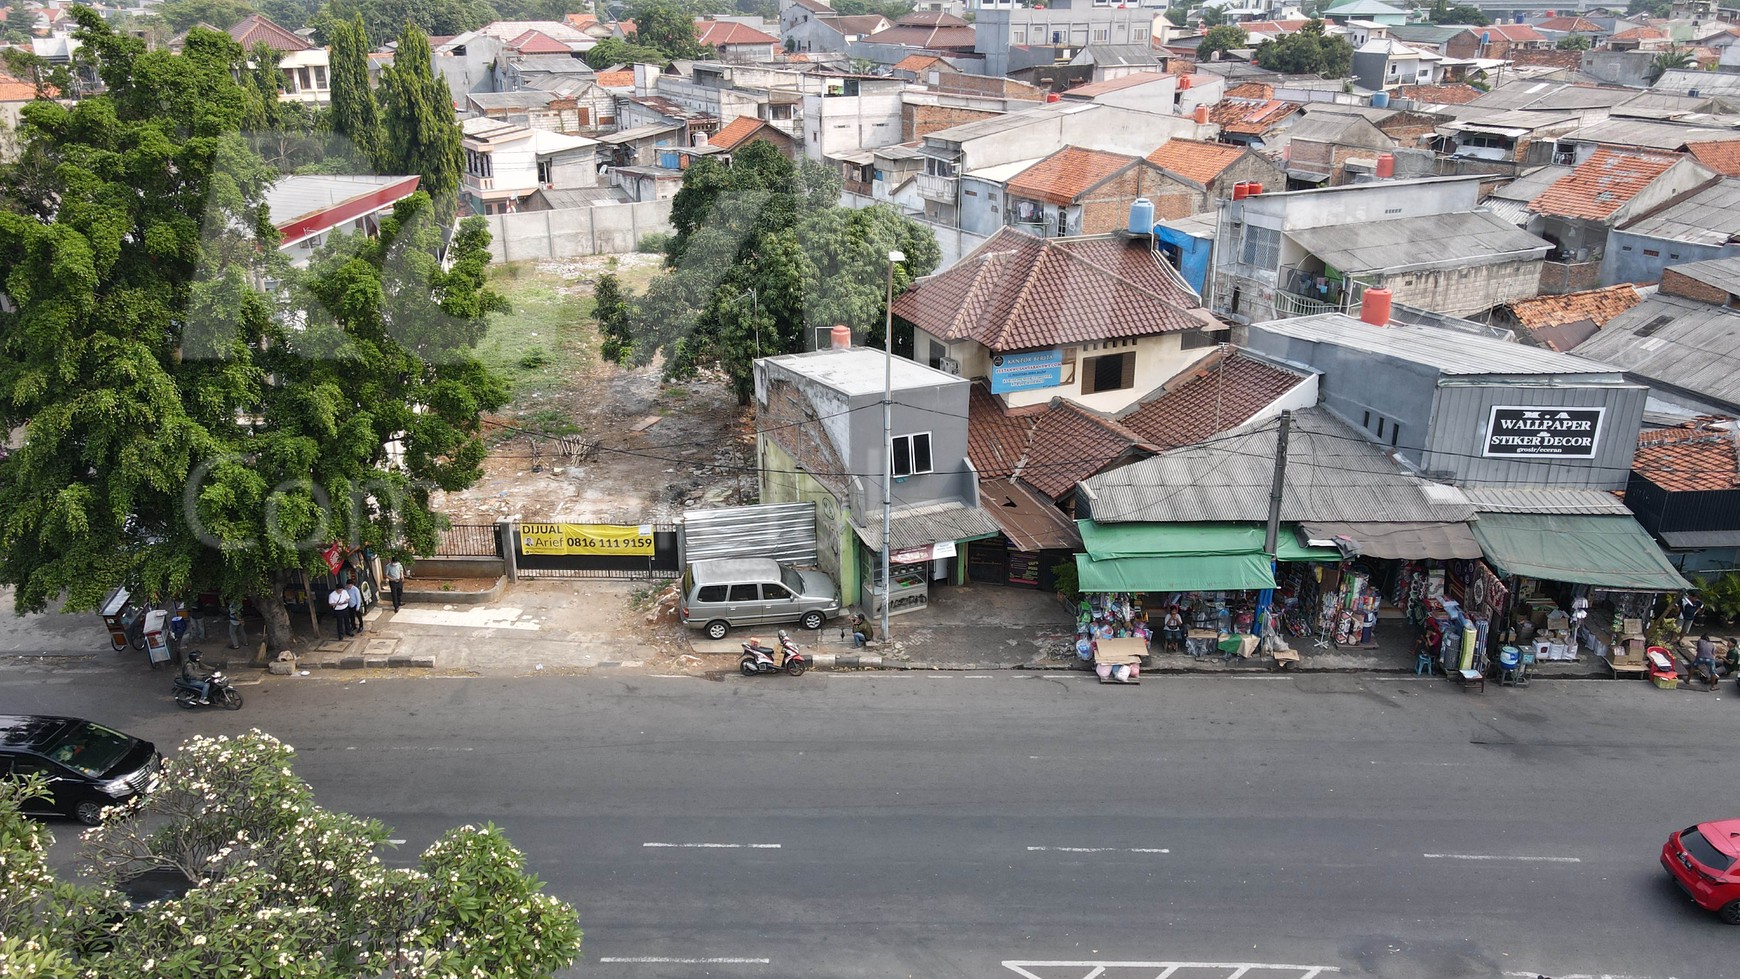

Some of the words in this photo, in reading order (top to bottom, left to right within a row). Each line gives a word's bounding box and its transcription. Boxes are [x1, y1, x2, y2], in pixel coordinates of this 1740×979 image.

[1500, 419, 1592, 431] WALLPAPER
[1491, 435, 1542, 446] STIKER
[1543, 436, 1592, 447] DECOR
[522, 525, 563, 534] DIJUAL
[535, 537, 564, 547] Arief
[567, 537, 596, 548] 0816
[600, 538, 620, 548] 111
[623, 538, 652, 548] 9159
